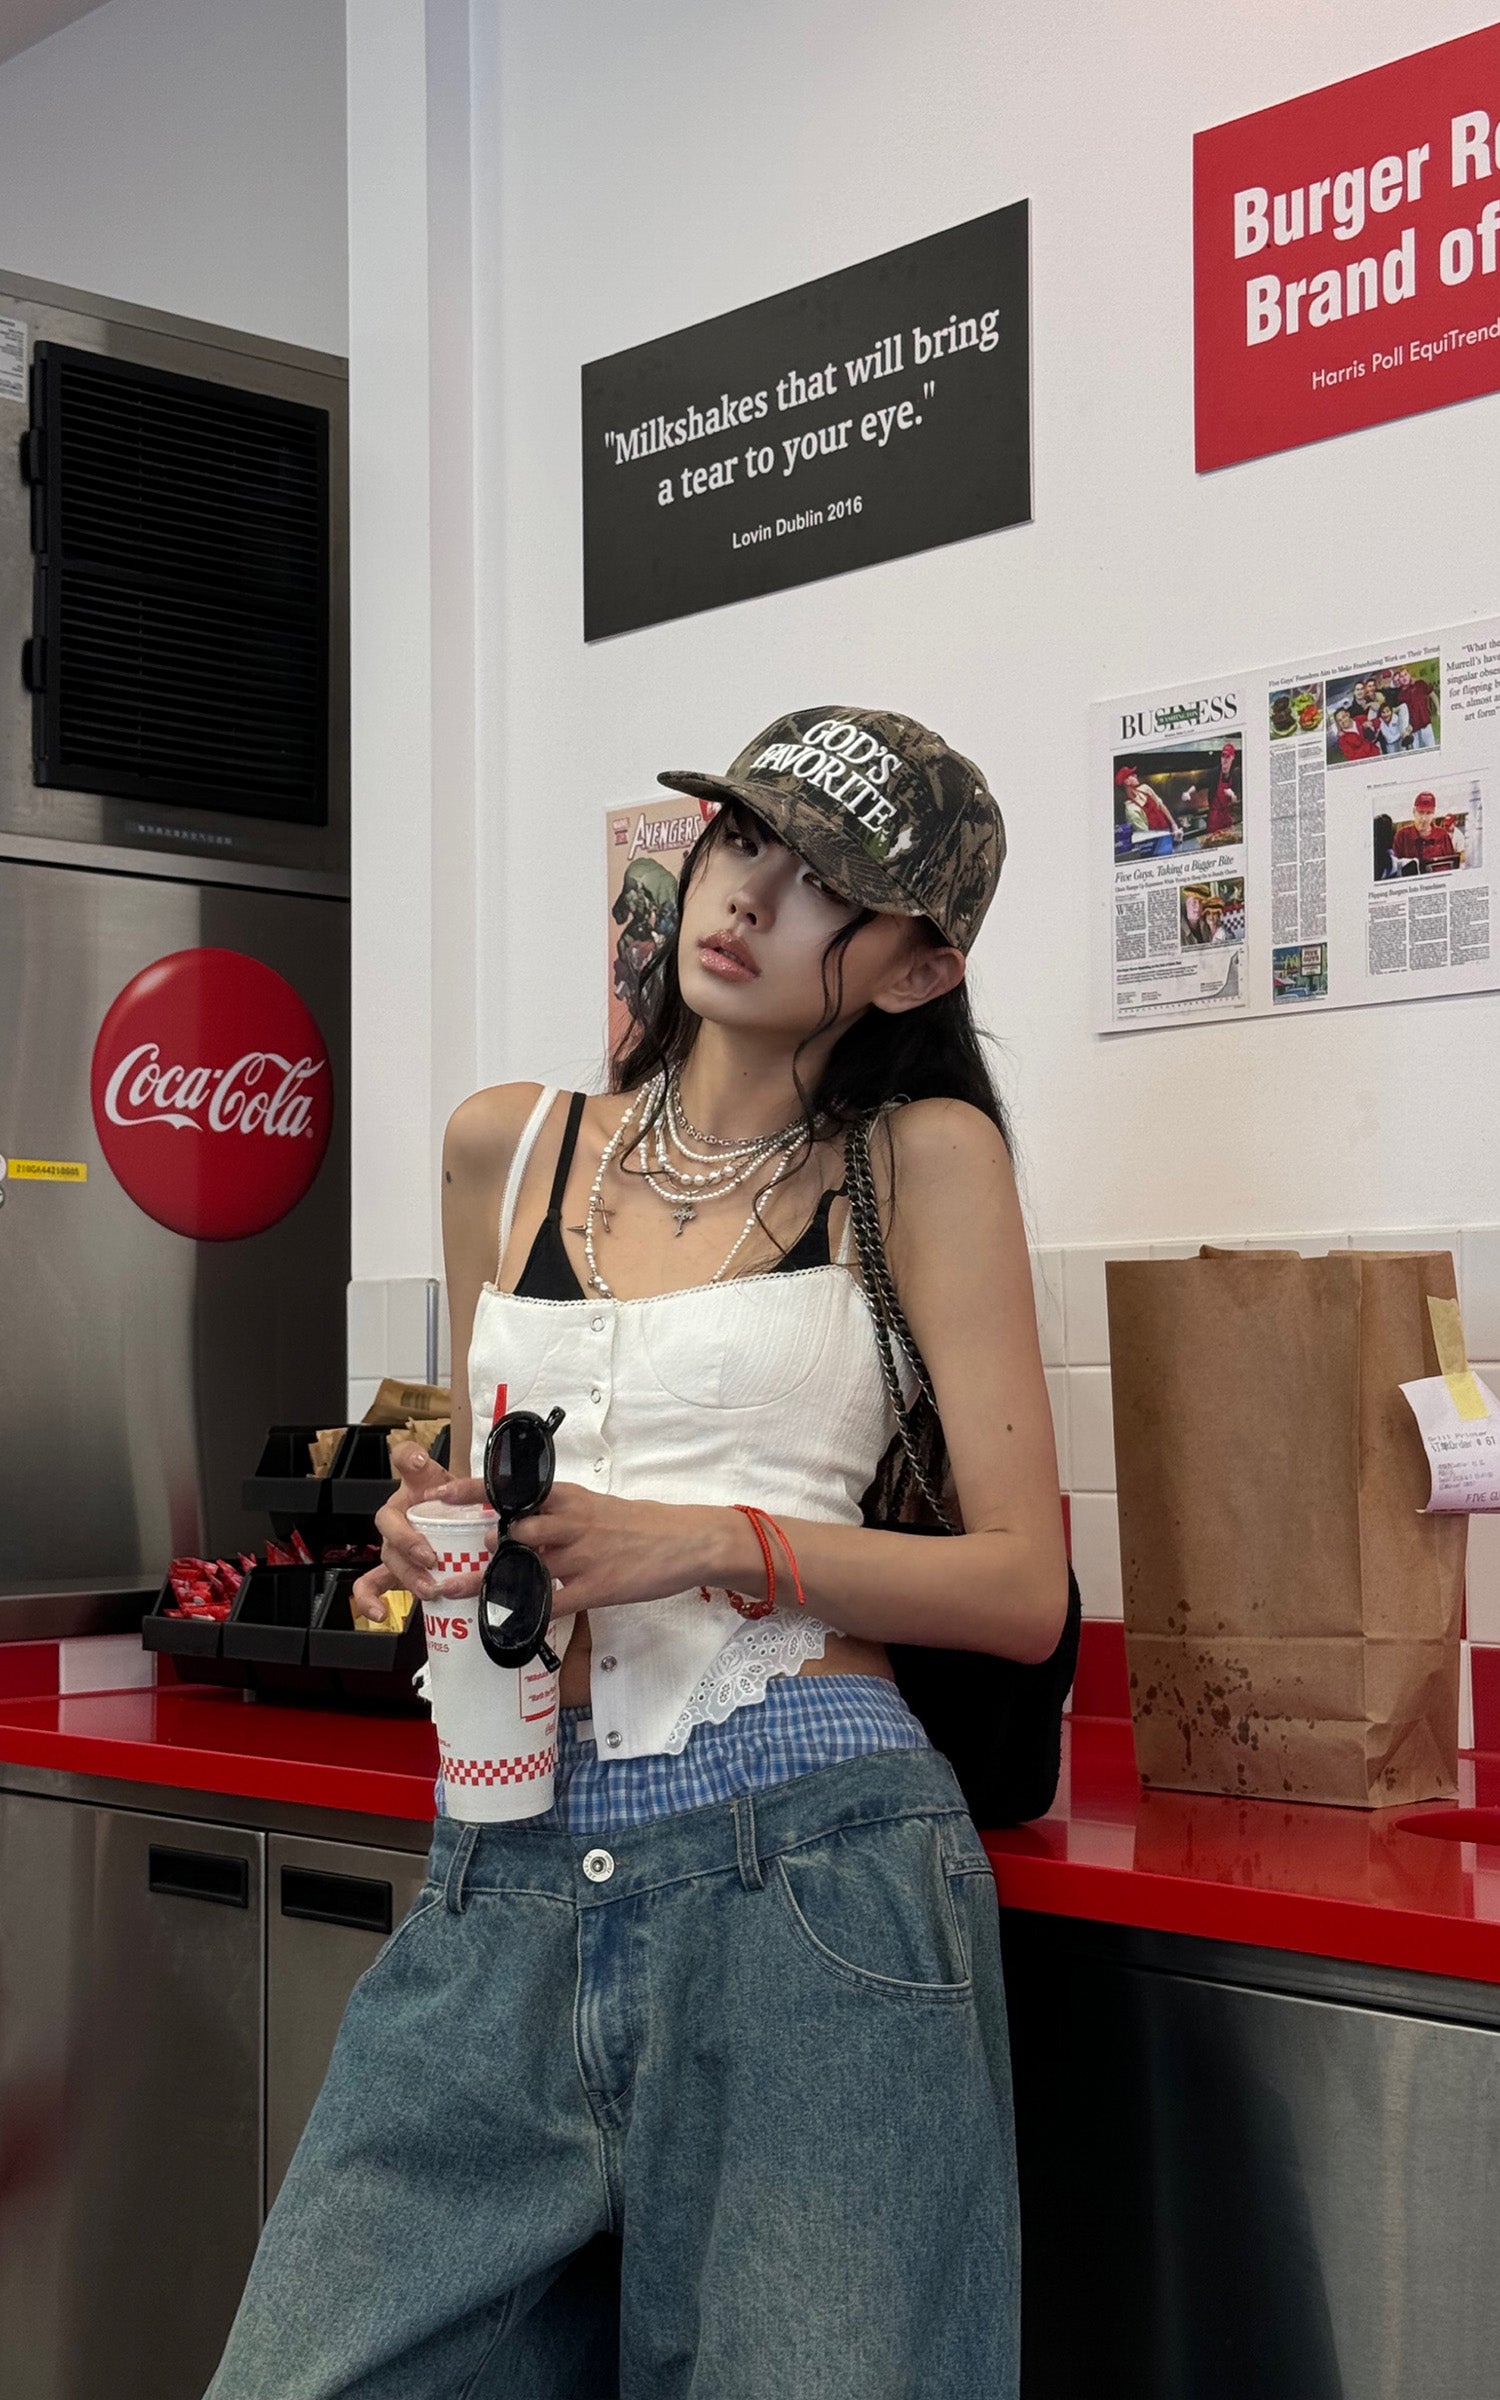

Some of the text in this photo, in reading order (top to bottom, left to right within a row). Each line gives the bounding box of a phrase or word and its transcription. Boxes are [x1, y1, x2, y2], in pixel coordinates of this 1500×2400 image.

[1233, 110, 1500, 260] Burger R
[1246, 227, 1416, 347] Brand
[1312, 319, 1500, 390] Harris Poll EquiTrend
[603, 309, 1000, 464] "Milkshakes that will bring
[656, 380, 936, 506] a tear to your eye."
[732, 495, 863, 549] Lovin Dublin 2016
[1447, 671, 1478, 685] singular
[1466, 696, 1492, 708] almost
[1120, 693, 1238, 740] BUSINESS
[802, 719, 902, 785] GOD'S
[750, 743, 897, 834] FAVORITE
[628, 813, 701, 860] AVENGERS
[1115, 872, 1132, 883] Five
[1156, 864, 1183, 876] Taking
[1184, 864, 1190, 872] a
[1191, 858, 1217, 872] Bigger
[1218, 855, 1234, 867] Bite
[104, 1042, 326, 1138] Coca-Cola
[1485, 1436, 1496, 1446] 61
[1465, 1492, 1487, 1503] FIVE
